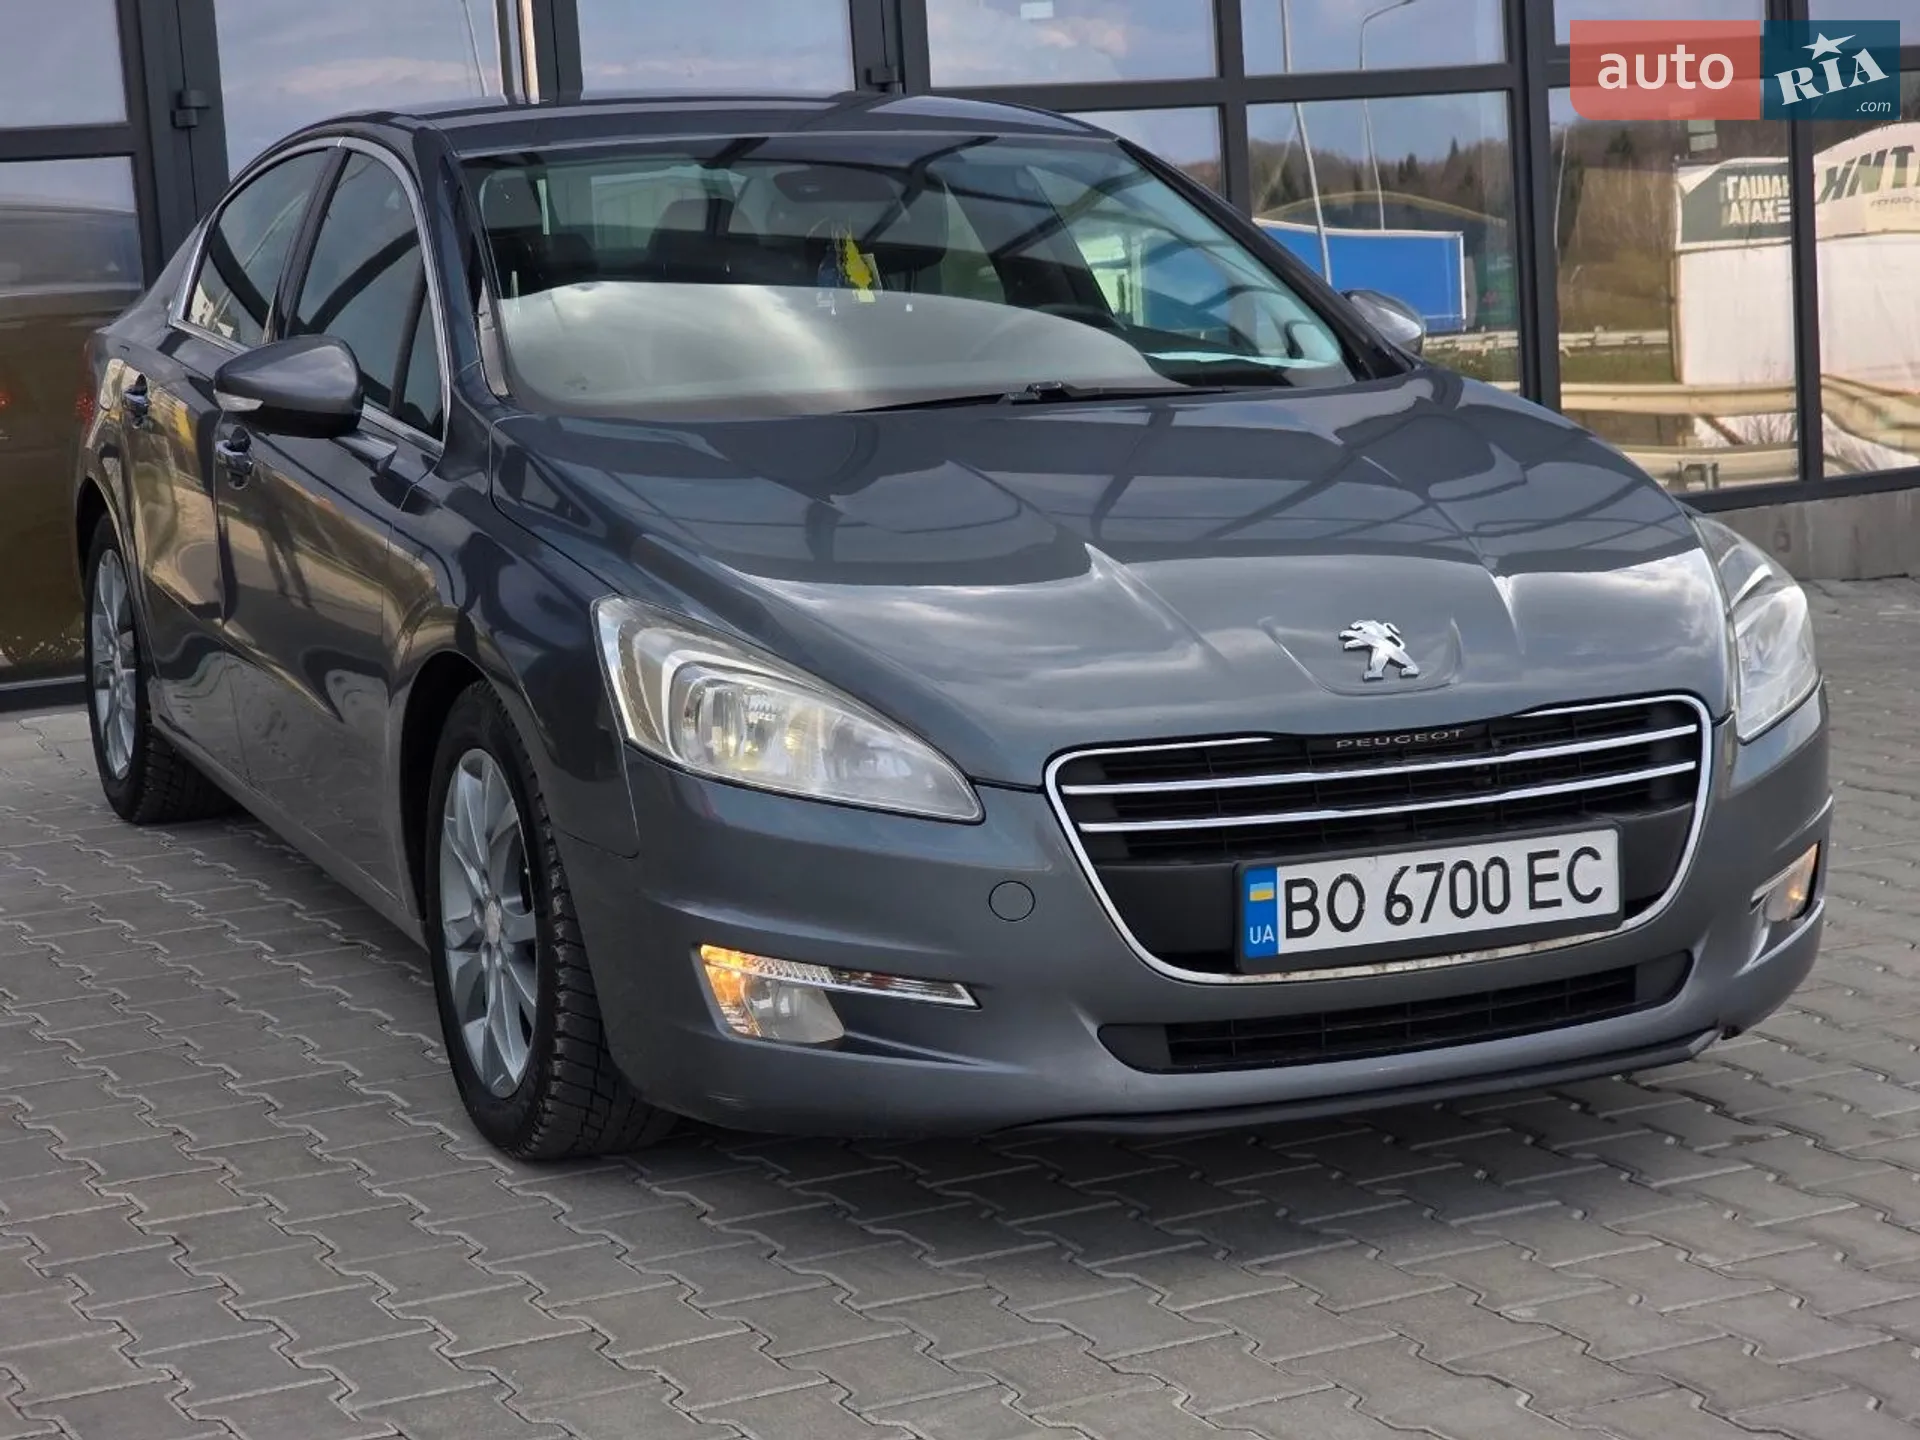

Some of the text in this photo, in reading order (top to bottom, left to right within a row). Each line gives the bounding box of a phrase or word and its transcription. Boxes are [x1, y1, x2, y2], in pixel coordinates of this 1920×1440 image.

[1336, 729, 1465, 749] PEUGEOT
[1284, 846, 1604, 940] BO 6700 EC
[1249, 924, 1275, 945] UA
